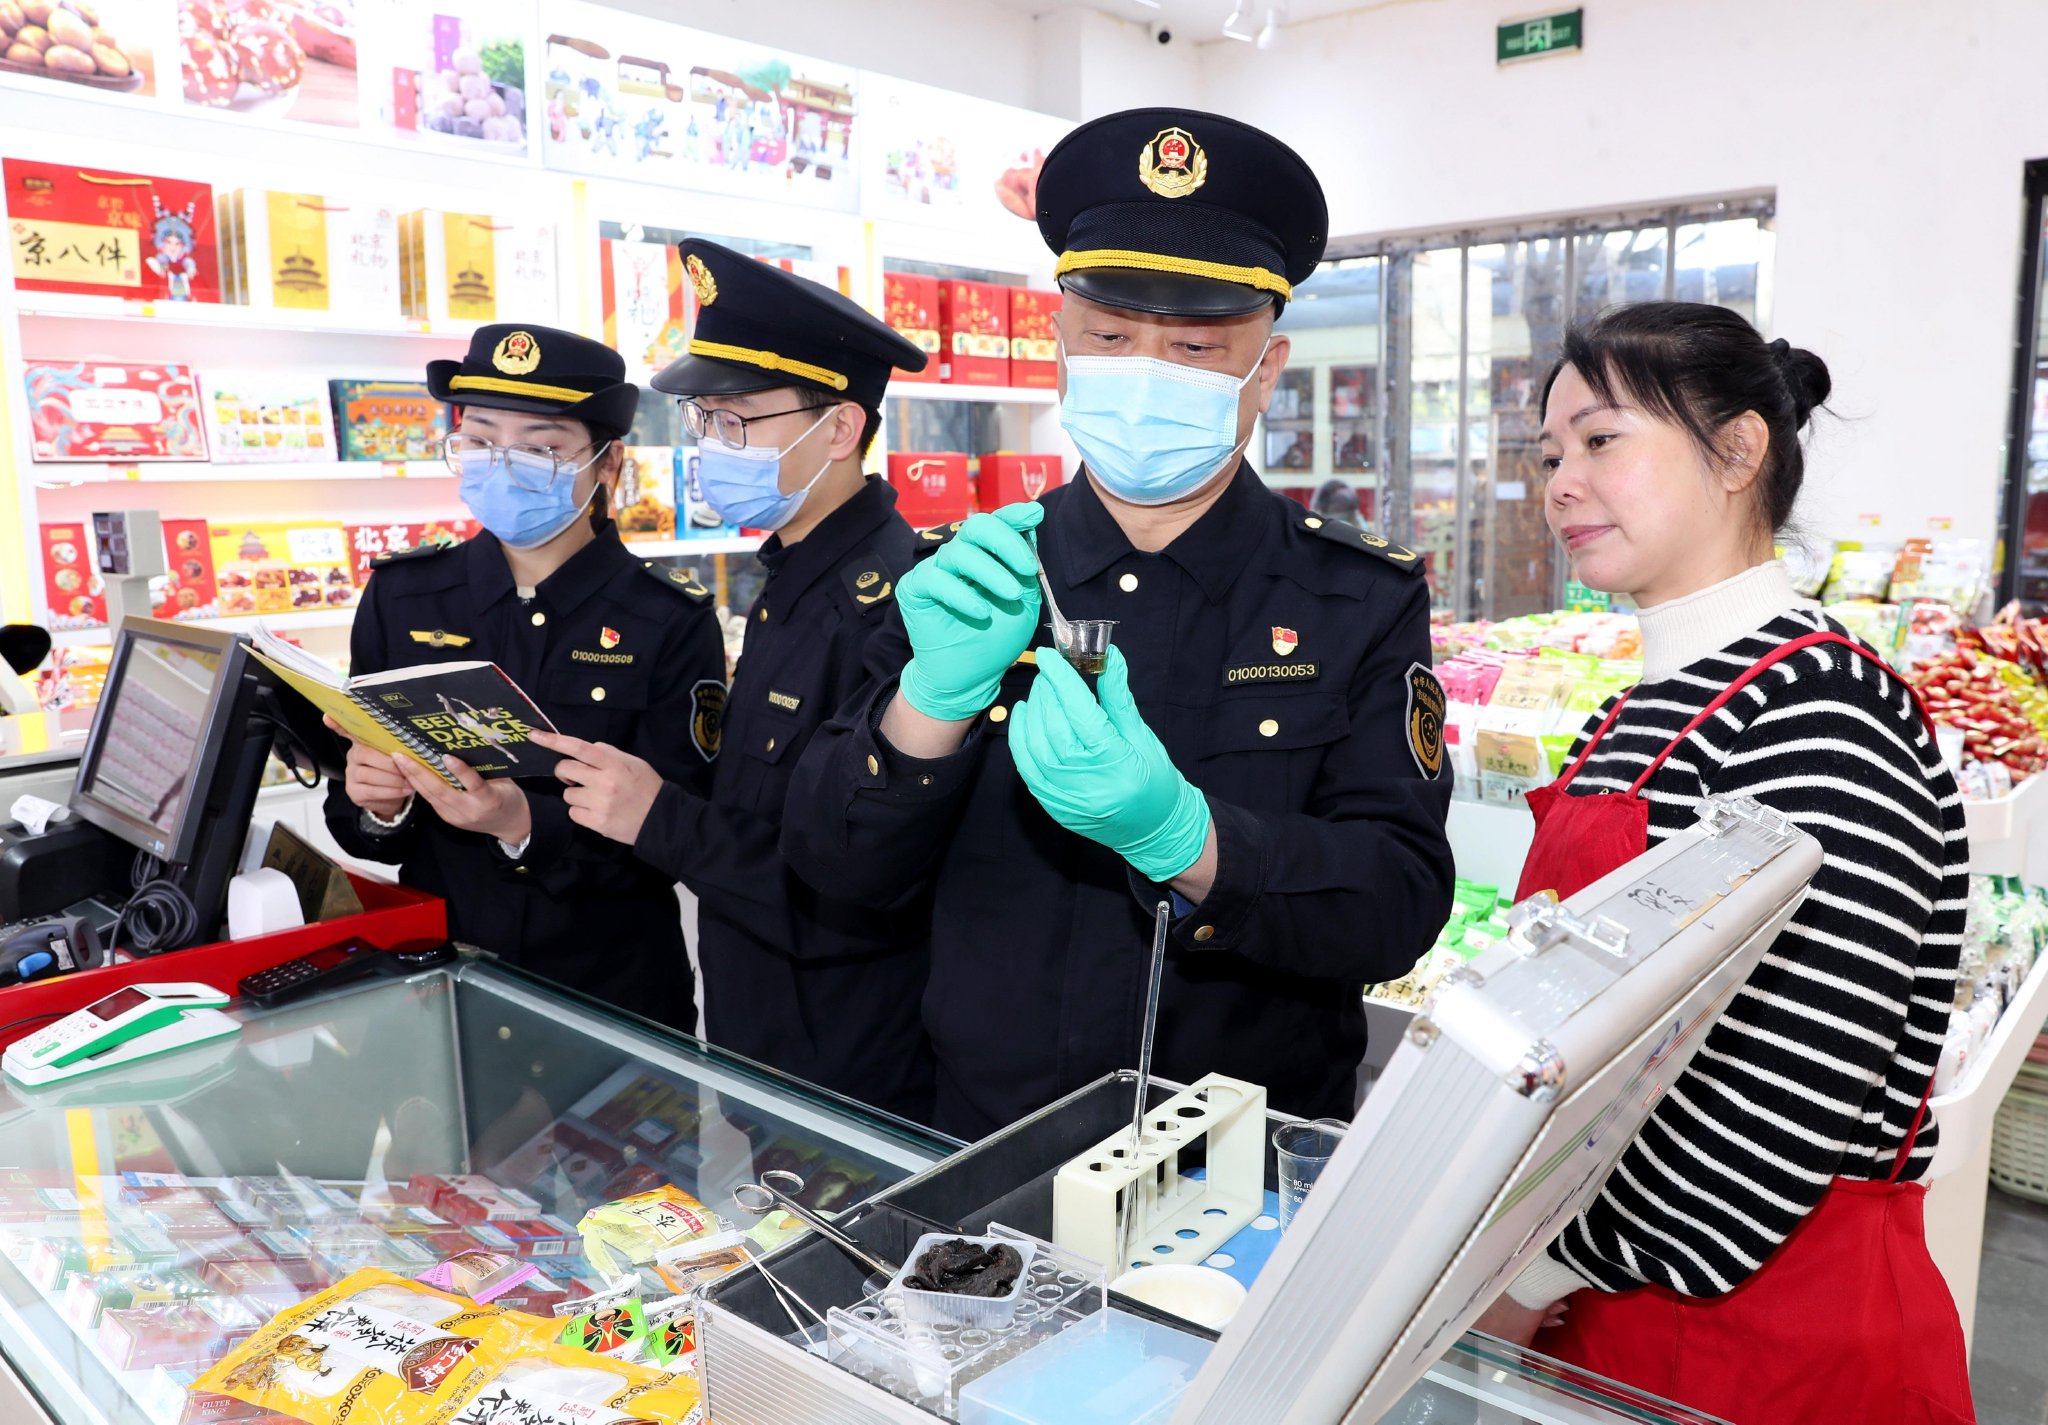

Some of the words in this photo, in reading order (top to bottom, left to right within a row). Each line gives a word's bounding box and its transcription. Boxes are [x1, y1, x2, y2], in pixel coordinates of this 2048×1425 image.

[18, 231, 128, 273] 京八件
[354, 526, 410, 552] 北京
[572, 650, 633, 664] 01000130509
[1228, 664, 1315, 682] 01000130053
[202, 1400, 230, 1409] FILTER
